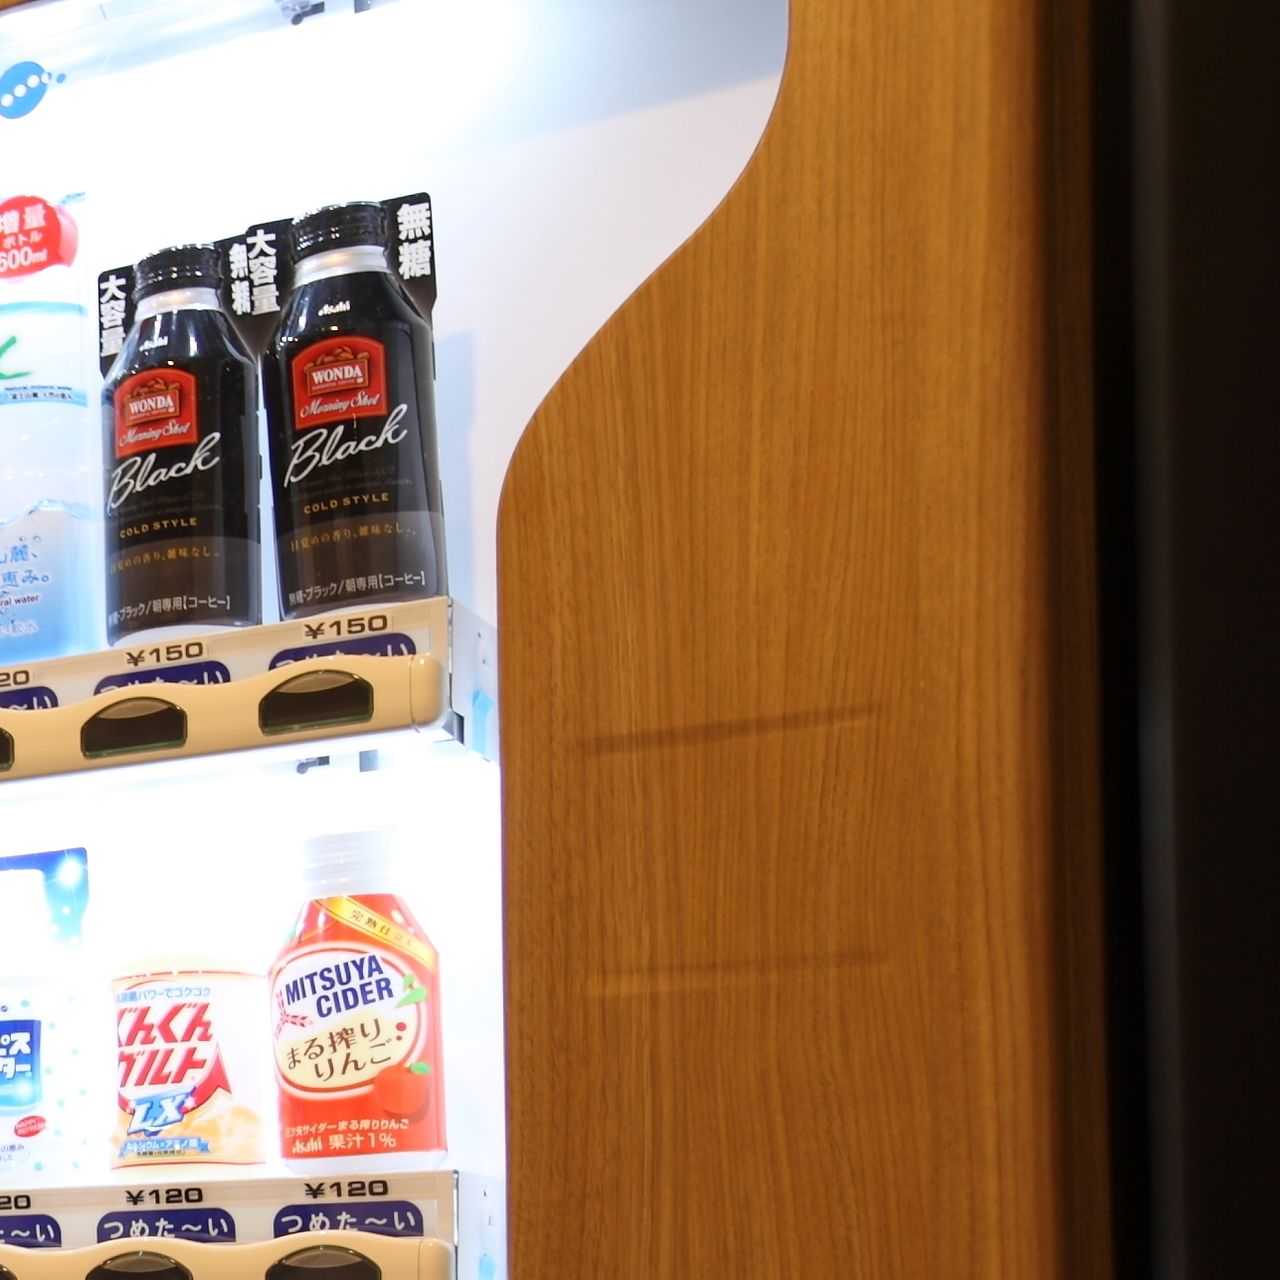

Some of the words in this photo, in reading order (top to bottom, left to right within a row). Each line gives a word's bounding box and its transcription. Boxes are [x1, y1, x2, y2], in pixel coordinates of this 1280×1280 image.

[2, 231, 44, 250] ボトル
[398, 203, 432, 279] 無糖
[318, 299, 351, 317] Asahi
[311, 364, 363, 384] WONDA
[128, 394, 174, 415] WONDA
[300, 397, 348, 418] Morning
[283, 403, 408, 487] Black
[106, 431, 221, 512] Black
[303, 499, 338, 515] COLD
[343, 491, 391, 508] STYLE
[119, 522, 149, 539] COLD
[152, 516, 199, 531] STYLE
[14, 593, 40, 605] water
[304, 614, 389, 640] ¥150
[126, 641, 204, 668] ¥150
[285, 954, 385, 1006] MITSUYA
[316, 977, 394, 1018] CIDER
[286, 1018, 382, 1070] まる搾り
[314, 1038, 392, 1082] りんご
[127, 1093, 188, 1135] LX
[292, 1136, 323, 1155] Asahi
[328, 1132, 397, 1151] 果汁1%
[125, 1187, 203, 1206] ¥120
[304, 1179, 389, 1198] ¥120
